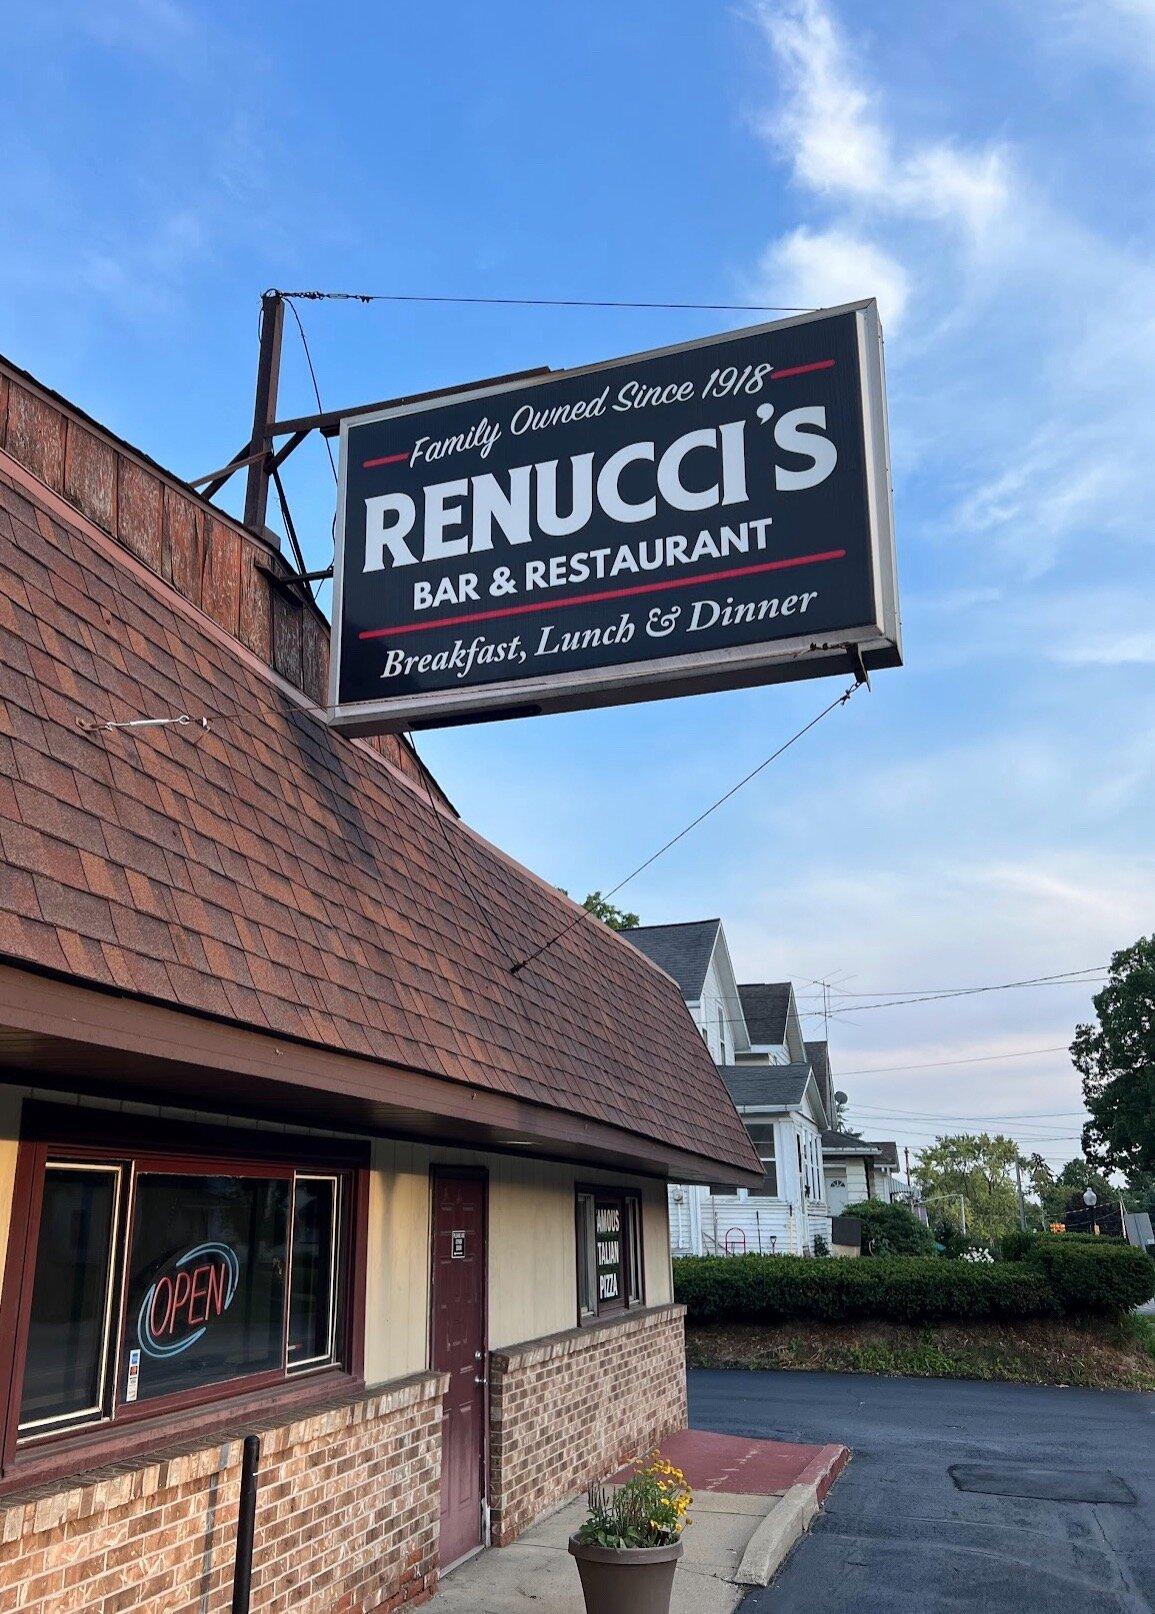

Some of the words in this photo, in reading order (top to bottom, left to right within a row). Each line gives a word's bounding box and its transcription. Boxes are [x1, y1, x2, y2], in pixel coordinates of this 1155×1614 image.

[409, 417, 502, 469] Family
[510, 385, 611, 435] Owned
[612, 380, 695, 413] Since
[703, 363, 774, 398] 1918
[362, 403, 837, 573] RENUCCI'S
[413, 572, 481, 611] BAR
[489, 566, 517, 597] &
[525, 517, 772, 591] RESTAURANT
[380, 635, 527, 679] Breakfast,
[534, 614, 635, 656] Lunch
[646, 605, 681, 638] &
[686, 590, 819, 633] Dinner
[597, 1209, 620, 1232] AMOUS
[597, 1241, 619, 1265] TALIAN
[151, 1263, 226, 1337] OPEN
[600, 1273, 618, 1299] PIZZA
